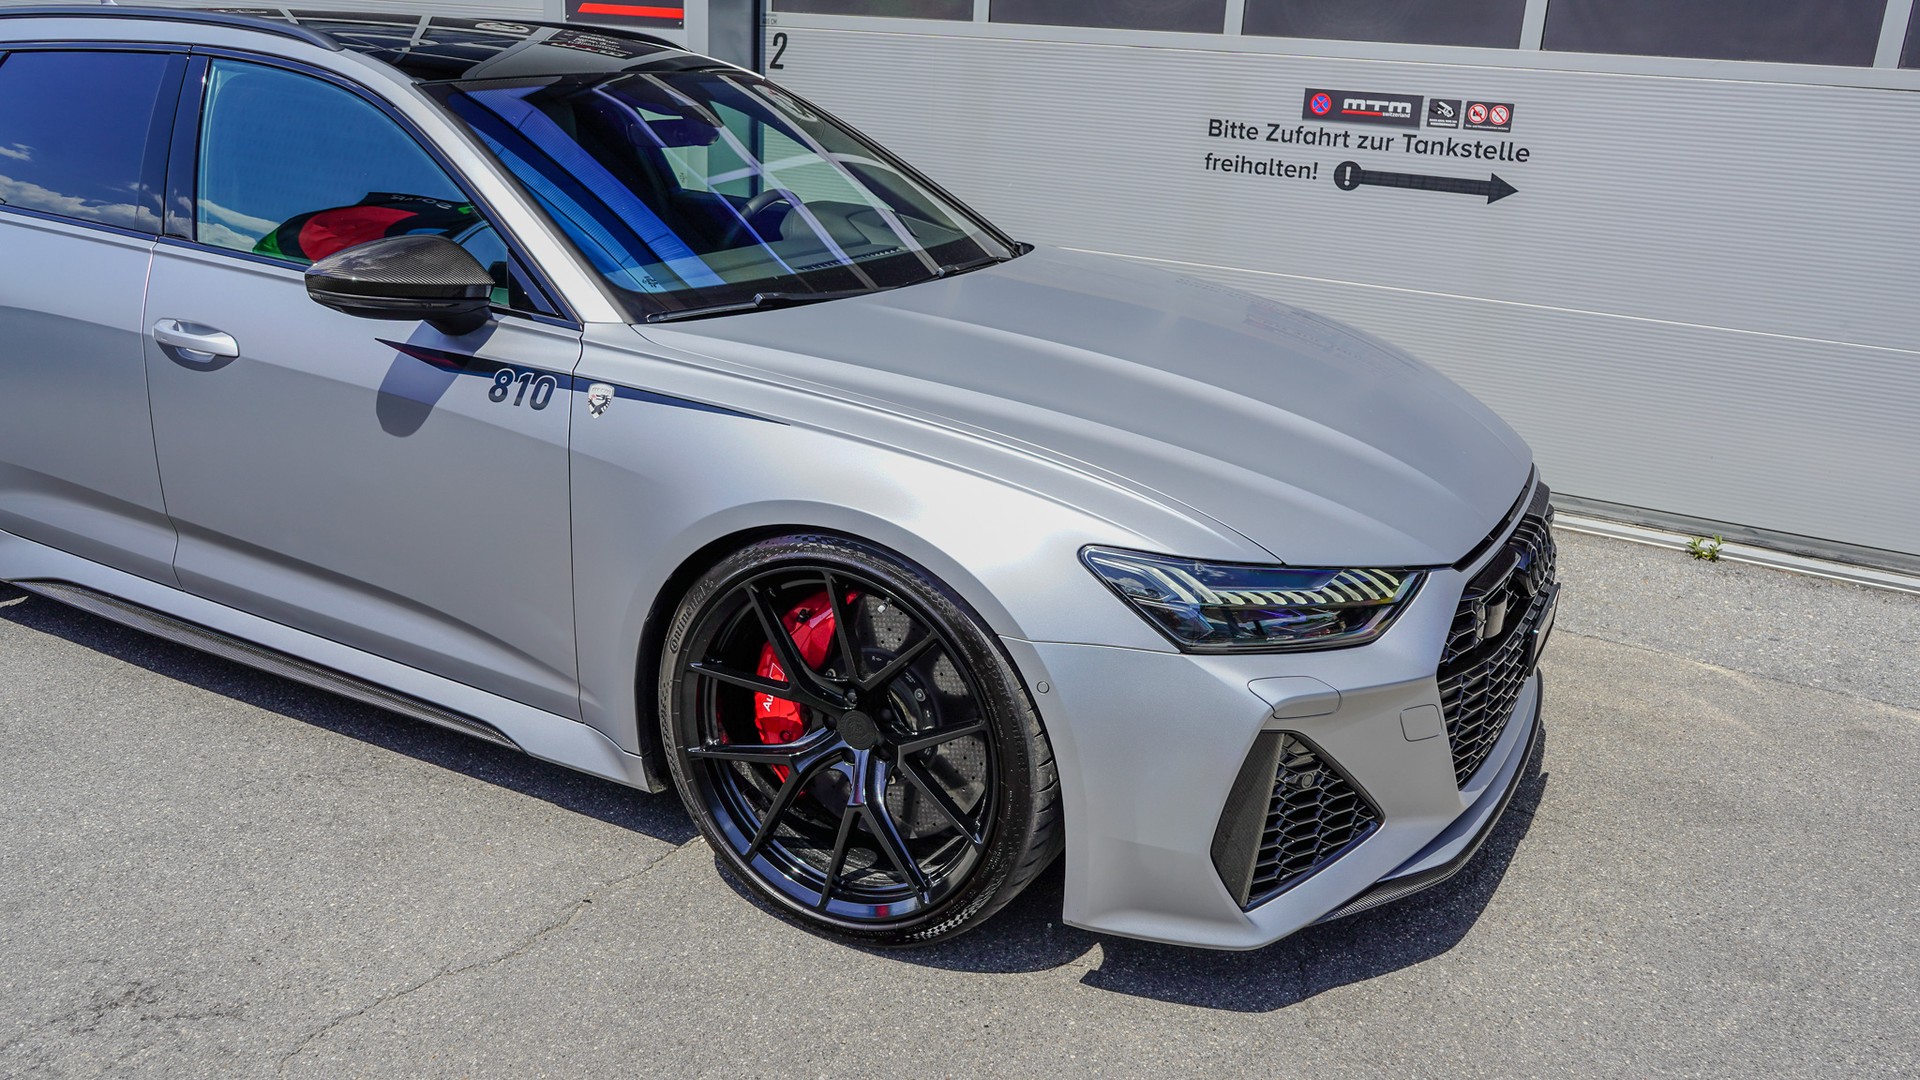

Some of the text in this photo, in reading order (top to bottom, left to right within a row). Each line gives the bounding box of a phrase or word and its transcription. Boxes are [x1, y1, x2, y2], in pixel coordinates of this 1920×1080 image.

[770, 32, 788, 70] 2
[1208, 118, 1530, 163] Bitte Zufahrt zur Tankstelle
[1205, 152, 1319, 181] freihalten!
[488, 368, 557, 411] 810
